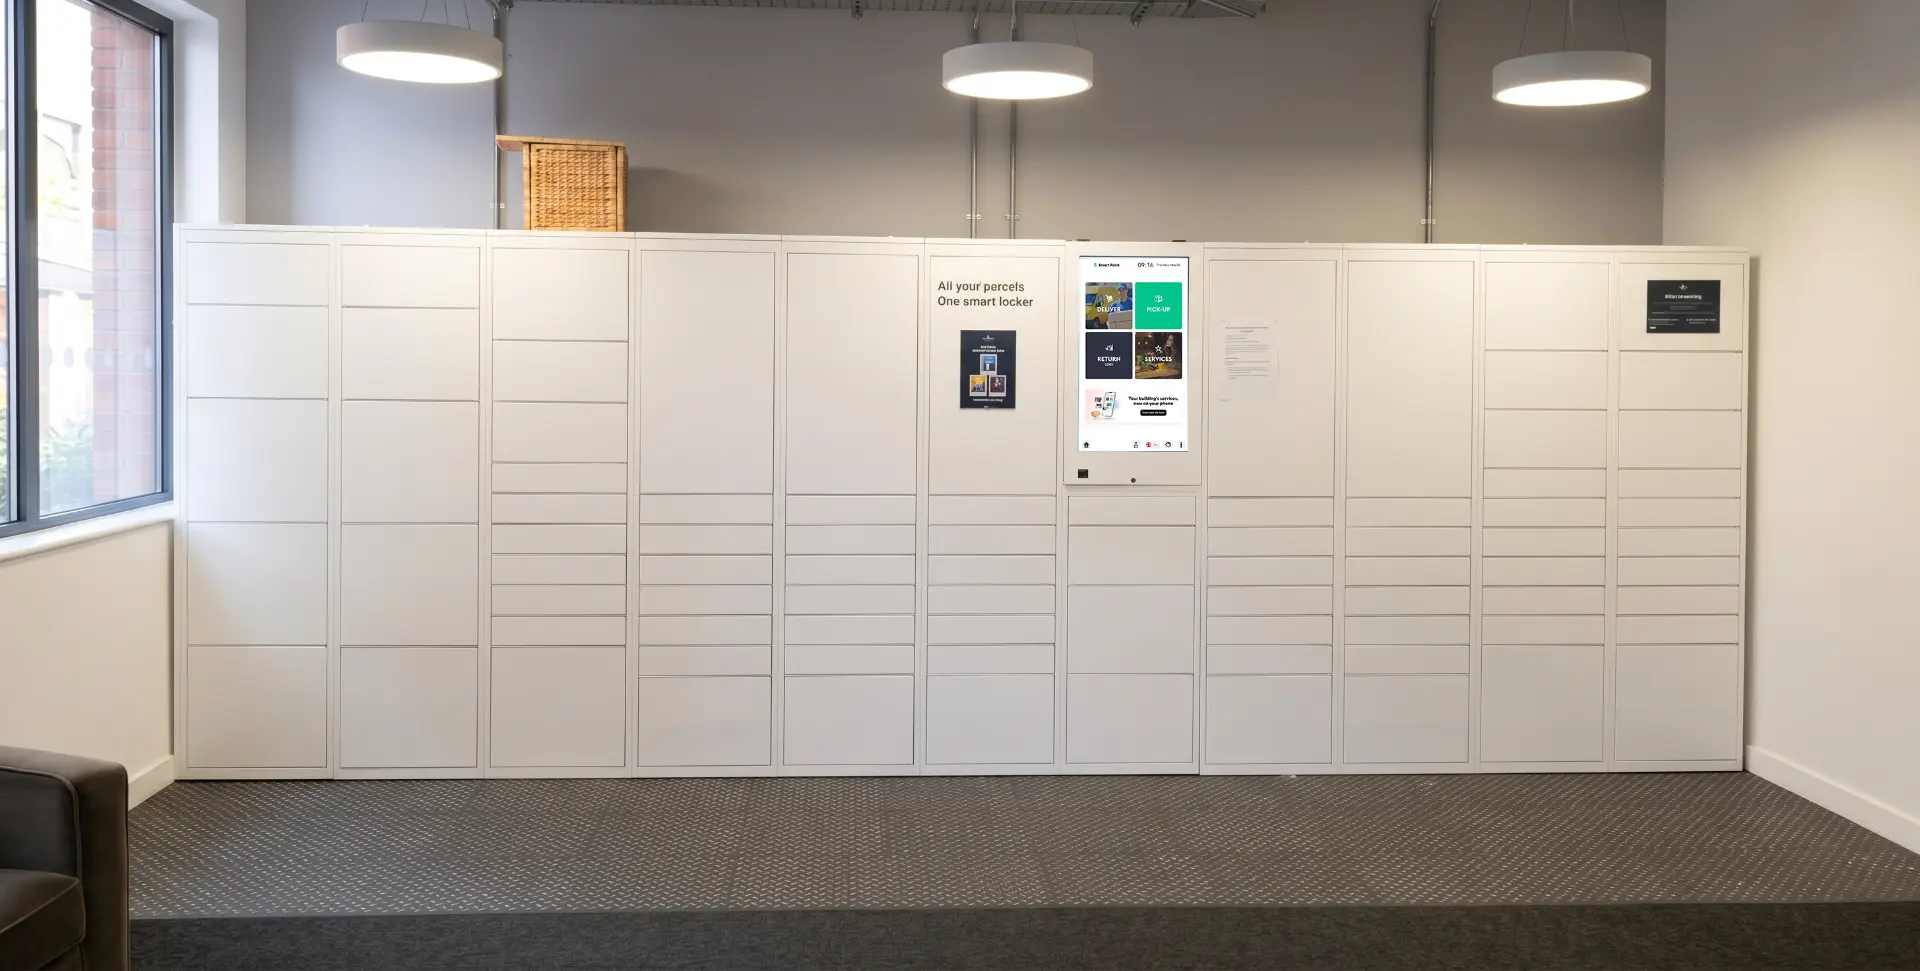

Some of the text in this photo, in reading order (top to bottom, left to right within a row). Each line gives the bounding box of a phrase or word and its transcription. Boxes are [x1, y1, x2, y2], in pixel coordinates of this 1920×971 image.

[937, 281, 1025, 293] All your percels
[937, 296, 1034, 307] One smart locker
